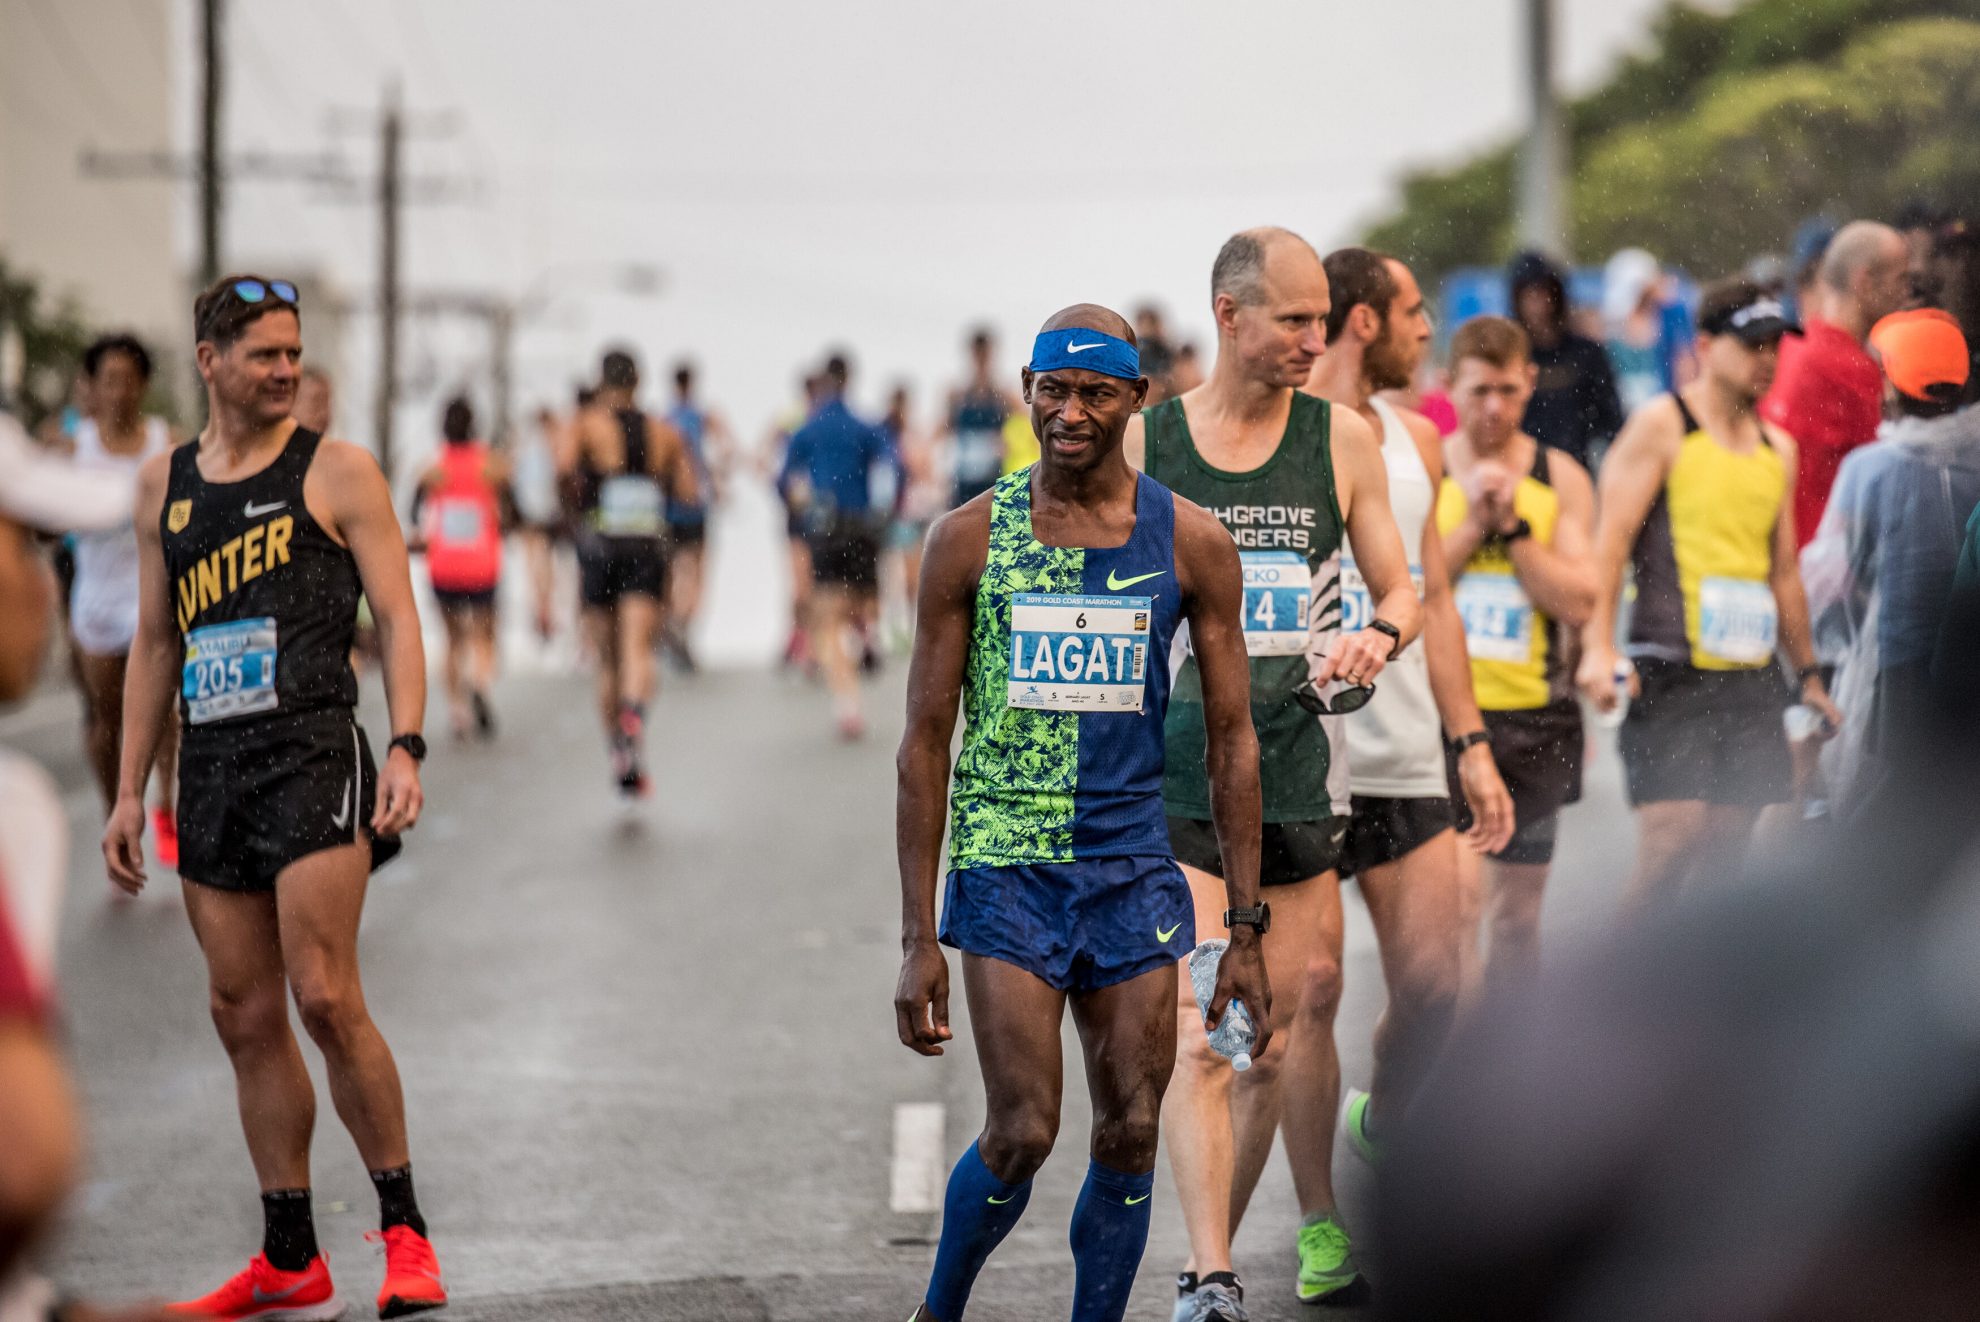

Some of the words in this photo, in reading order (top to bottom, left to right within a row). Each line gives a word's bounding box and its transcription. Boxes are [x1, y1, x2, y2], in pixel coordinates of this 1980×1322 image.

[1204, 505, 1317, 528] HGROVE
[1042, 596, 1061, 604] GOLD
[1063, 597, 1085, 605] COAST
[1085, 598, 1122, 606] MARATHON
[1076, 612, 1087, 629] 6
[1013, 634, 1131, 682] LAGAT
[195, 656, 243, 699] 205
